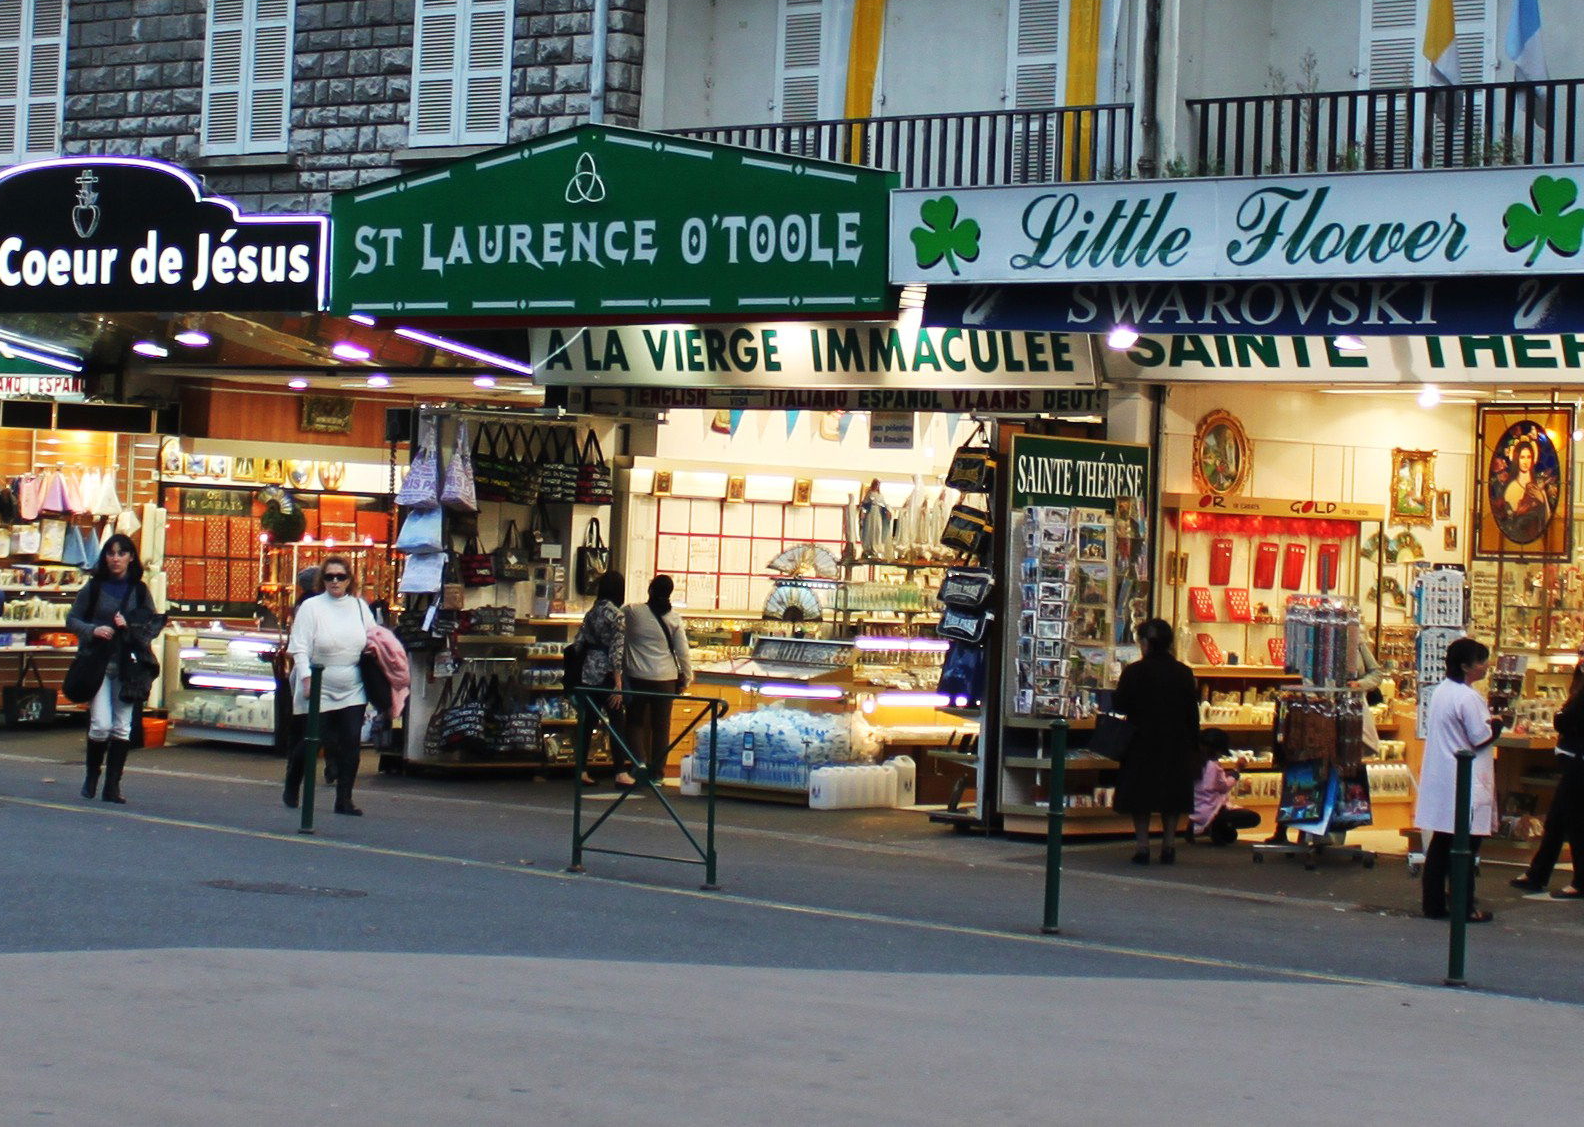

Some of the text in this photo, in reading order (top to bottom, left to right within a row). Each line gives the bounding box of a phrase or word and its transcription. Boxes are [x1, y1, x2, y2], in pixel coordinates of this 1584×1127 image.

[350, 211, 863, 278] ST LAURENCE O'TOOLE
[1009, 187, 1469, 270] Little Flower
[130, 230, 183, 285] de
[193, 229, 309, 291] Jésus
[1066, 281, 1437, 325] SWAROVSKI
[546, 329, 572, 371] A
[583, 329, 631, 371] LA
[642, 329, 781, 372] VIERGE
[639, 388, 708, 407] ENGLISH
[769, 390, 848, 407] ITALIANO
[952, 390, 1031, 410] VLAAMS
[1017, 451, 1144, 499] SAINTE THÉRÈSE
[1290, 500, 1337, 514] GOLD
